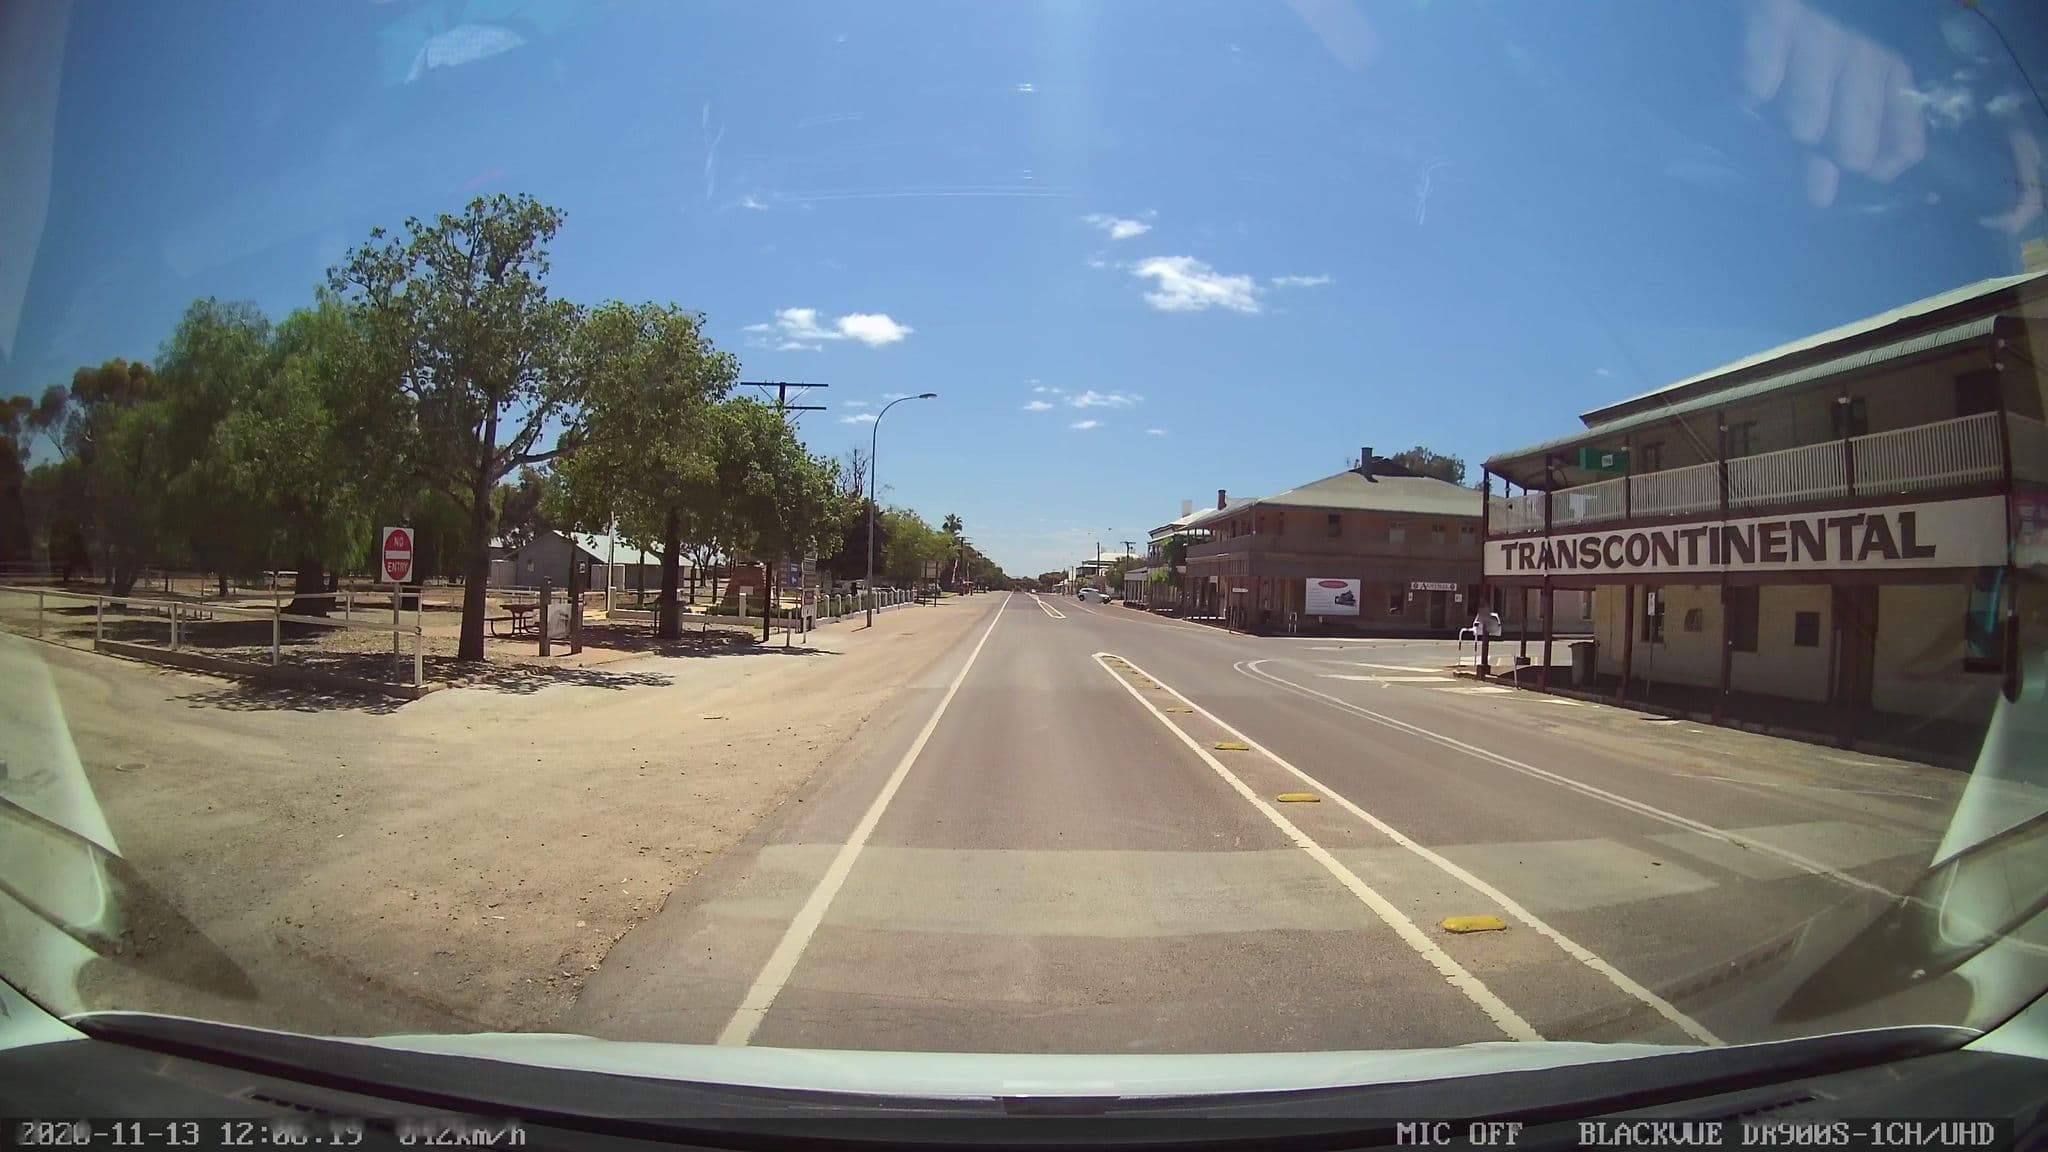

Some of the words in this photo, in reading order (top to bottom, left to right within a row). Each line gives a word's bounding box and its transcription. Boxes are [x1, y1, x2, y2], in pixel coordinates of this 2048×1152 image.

[394, 536, 404, 547] NO
[1501, 510, 1936, 571] TRANSCONTINENTAL
[388, 561, 409, 573] ENTRY
